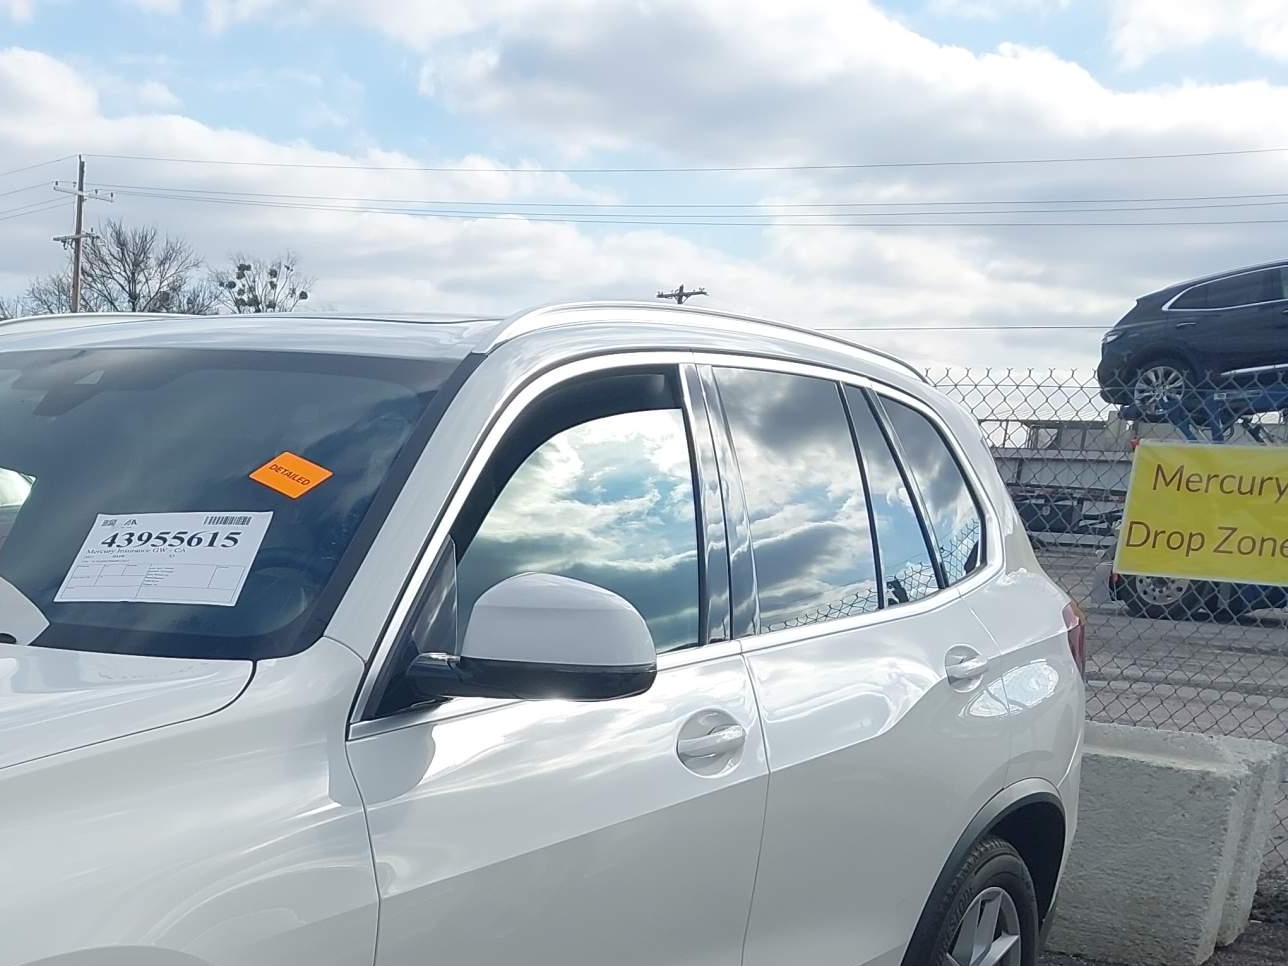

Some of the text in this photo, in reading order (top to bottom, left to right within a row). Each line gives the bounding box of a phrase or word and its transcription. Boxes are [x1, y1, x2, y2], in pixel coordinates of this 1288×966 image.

[267, 463, 311, 487] DETAILED
[1152, 463, 1288, 504] Mercury
[100, 530, 243, 549] 43955615
[1125, 521, 1288, 558] Drop Zone
